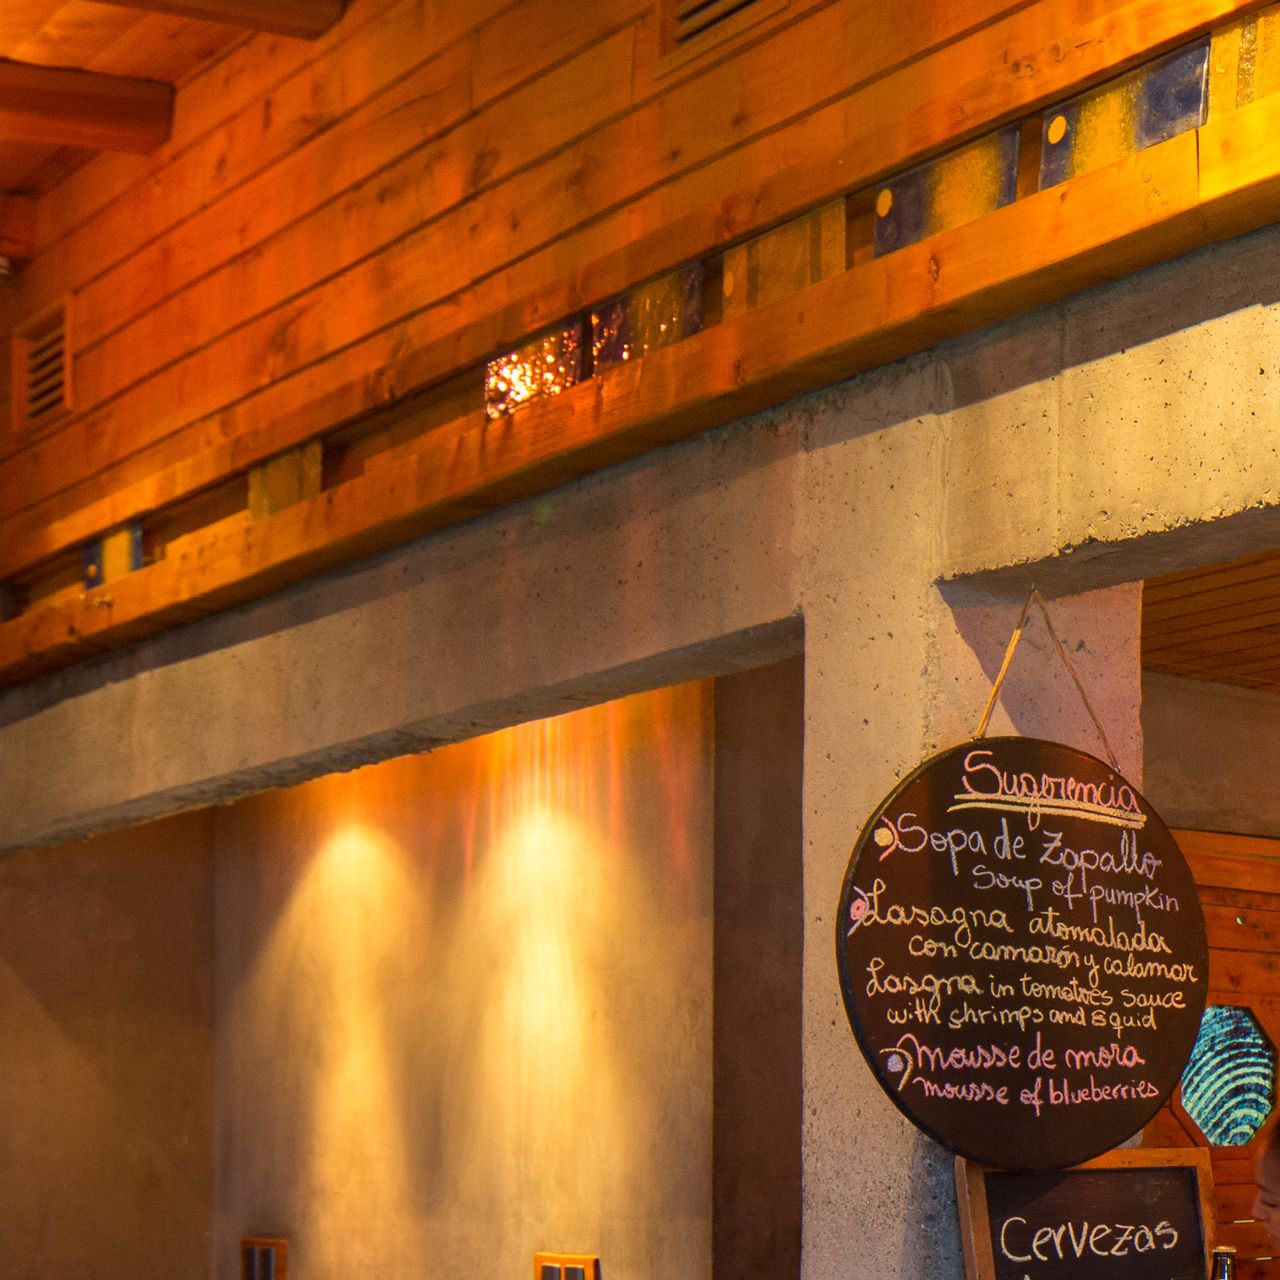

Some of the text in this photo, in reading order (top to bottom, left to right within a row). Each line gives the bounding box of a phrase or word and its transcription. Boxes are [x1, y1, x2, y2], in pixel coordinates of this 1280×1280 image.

[963, 751, 1142, 831] Sugerencia
[896, 813, 1163, 893] Sopa de Zapallo
[972, 864, 1042, 911] Soup
[1052, 872, 1082, 910] of
[862, 878, 1014, 948] Lasagna
[989, 974, 1015, 998] in
[1084, 953, 1101, 988] y
[1103, 952, 1199, 983] calamar
[886, 997, 942, 1025] with
[948, 1001, 1045, 1032] shrimps
[1049, 1006, 1087, 1027] and
[1027, 1030, 1057, 1070] de
[1065, 1042, 1146, 1070] mora
[1020, 1076, 1043, 1117] of
[1049, 1074, 1159, 1105] blueberries
[1001, 1216, 1179, 1263] Cervezas
